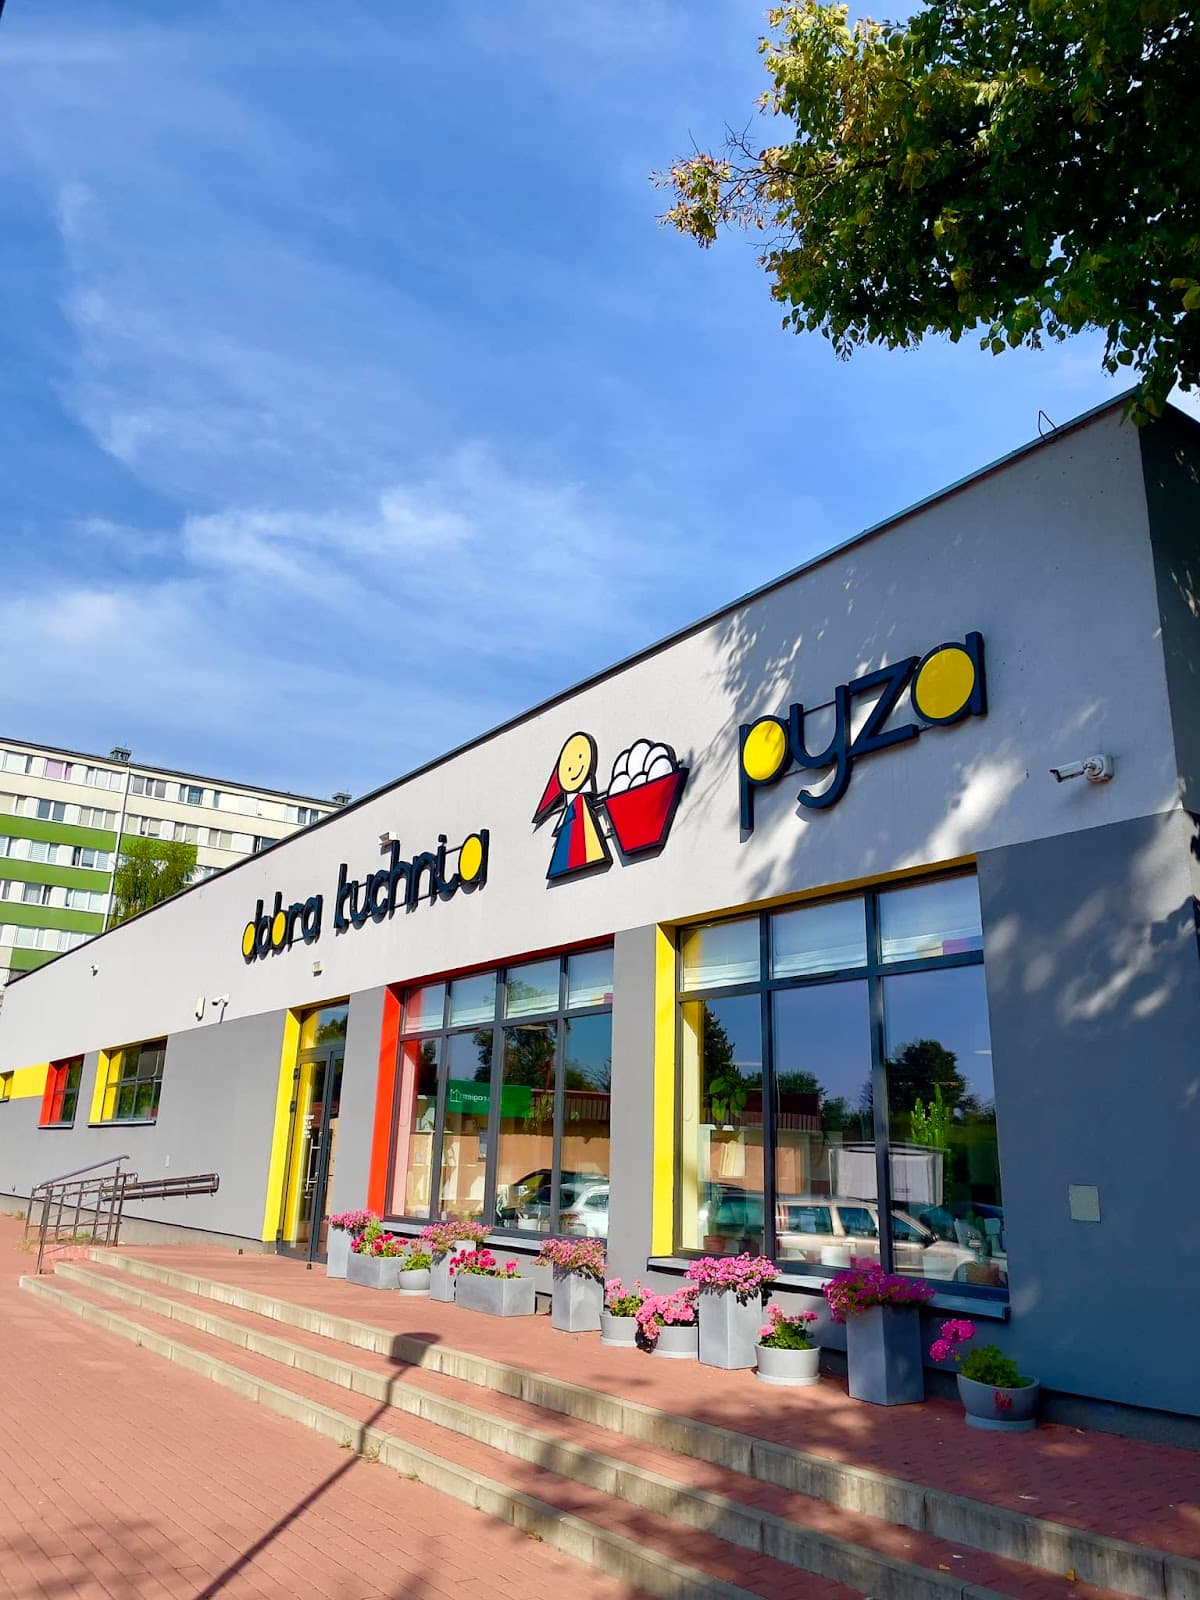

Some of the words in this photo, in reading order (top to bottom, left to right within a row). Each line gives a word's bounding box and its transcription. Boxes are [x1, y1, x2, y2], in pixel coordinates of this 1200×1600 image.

[739, 631, 987, 830] pyza
[242, 891, 323, 958] dobra
[334, 829, 490, 928] kuchnia
